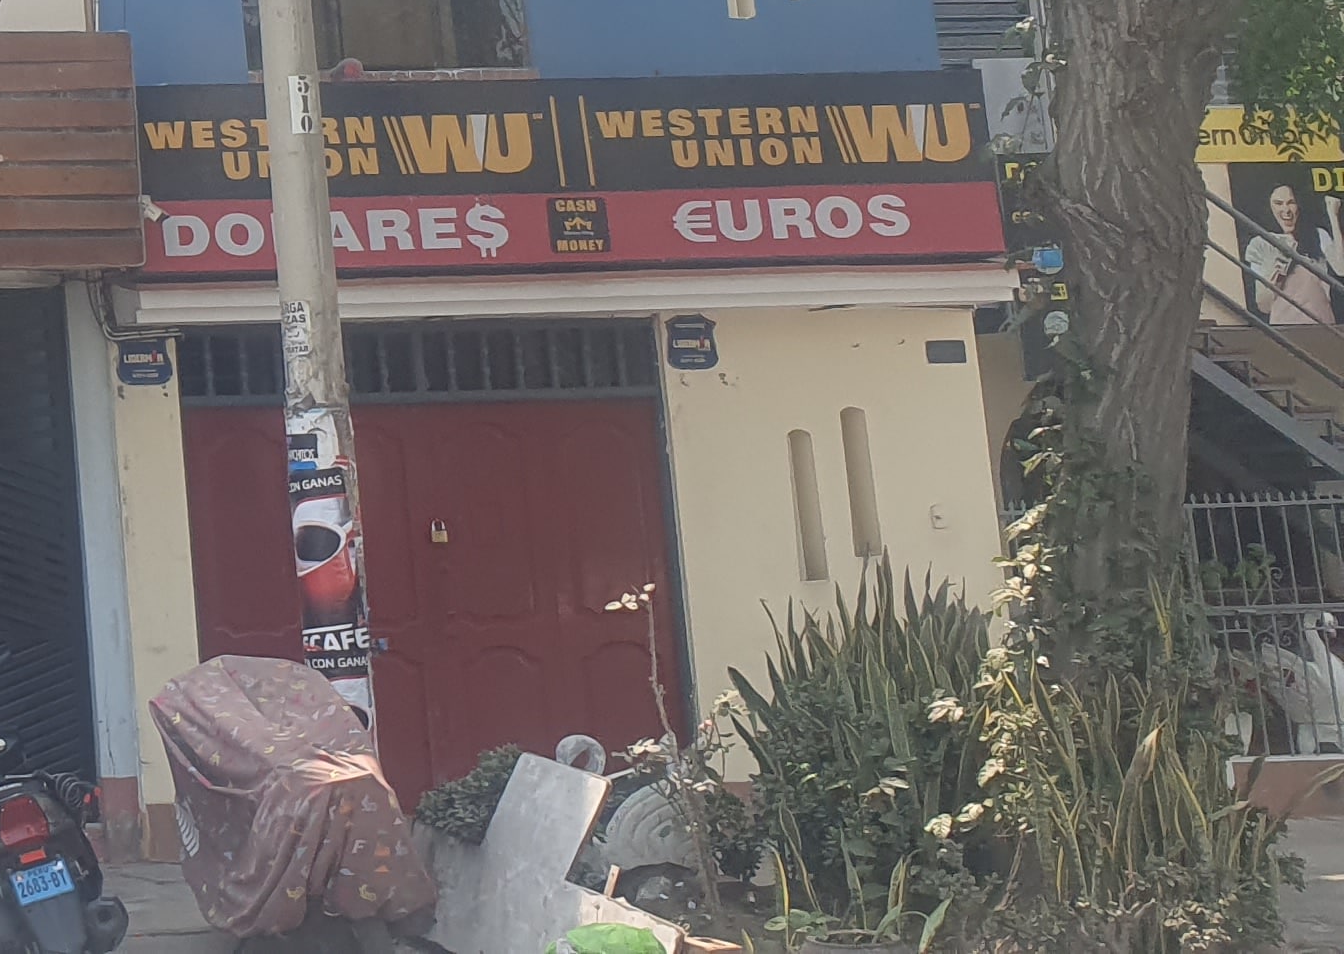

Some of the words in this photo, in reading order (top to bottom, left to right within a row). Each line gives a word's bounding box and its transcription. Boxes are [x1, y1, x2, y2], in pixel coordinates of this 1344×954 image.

[144, 116, 376, 149] WESTRN
[595, 105, 819, 139] WESTERN
[670, 136, 822, 169] UNION
[555, 199, 597, 212] CASH
[672, 194, 911, 242] €UROS
[162, 198, 509, 258] DOARE$
[556, 239, 604, 251] MONEY
[302, 475, 343, 491] GANAS
[312, 658, 334, 668] CON
